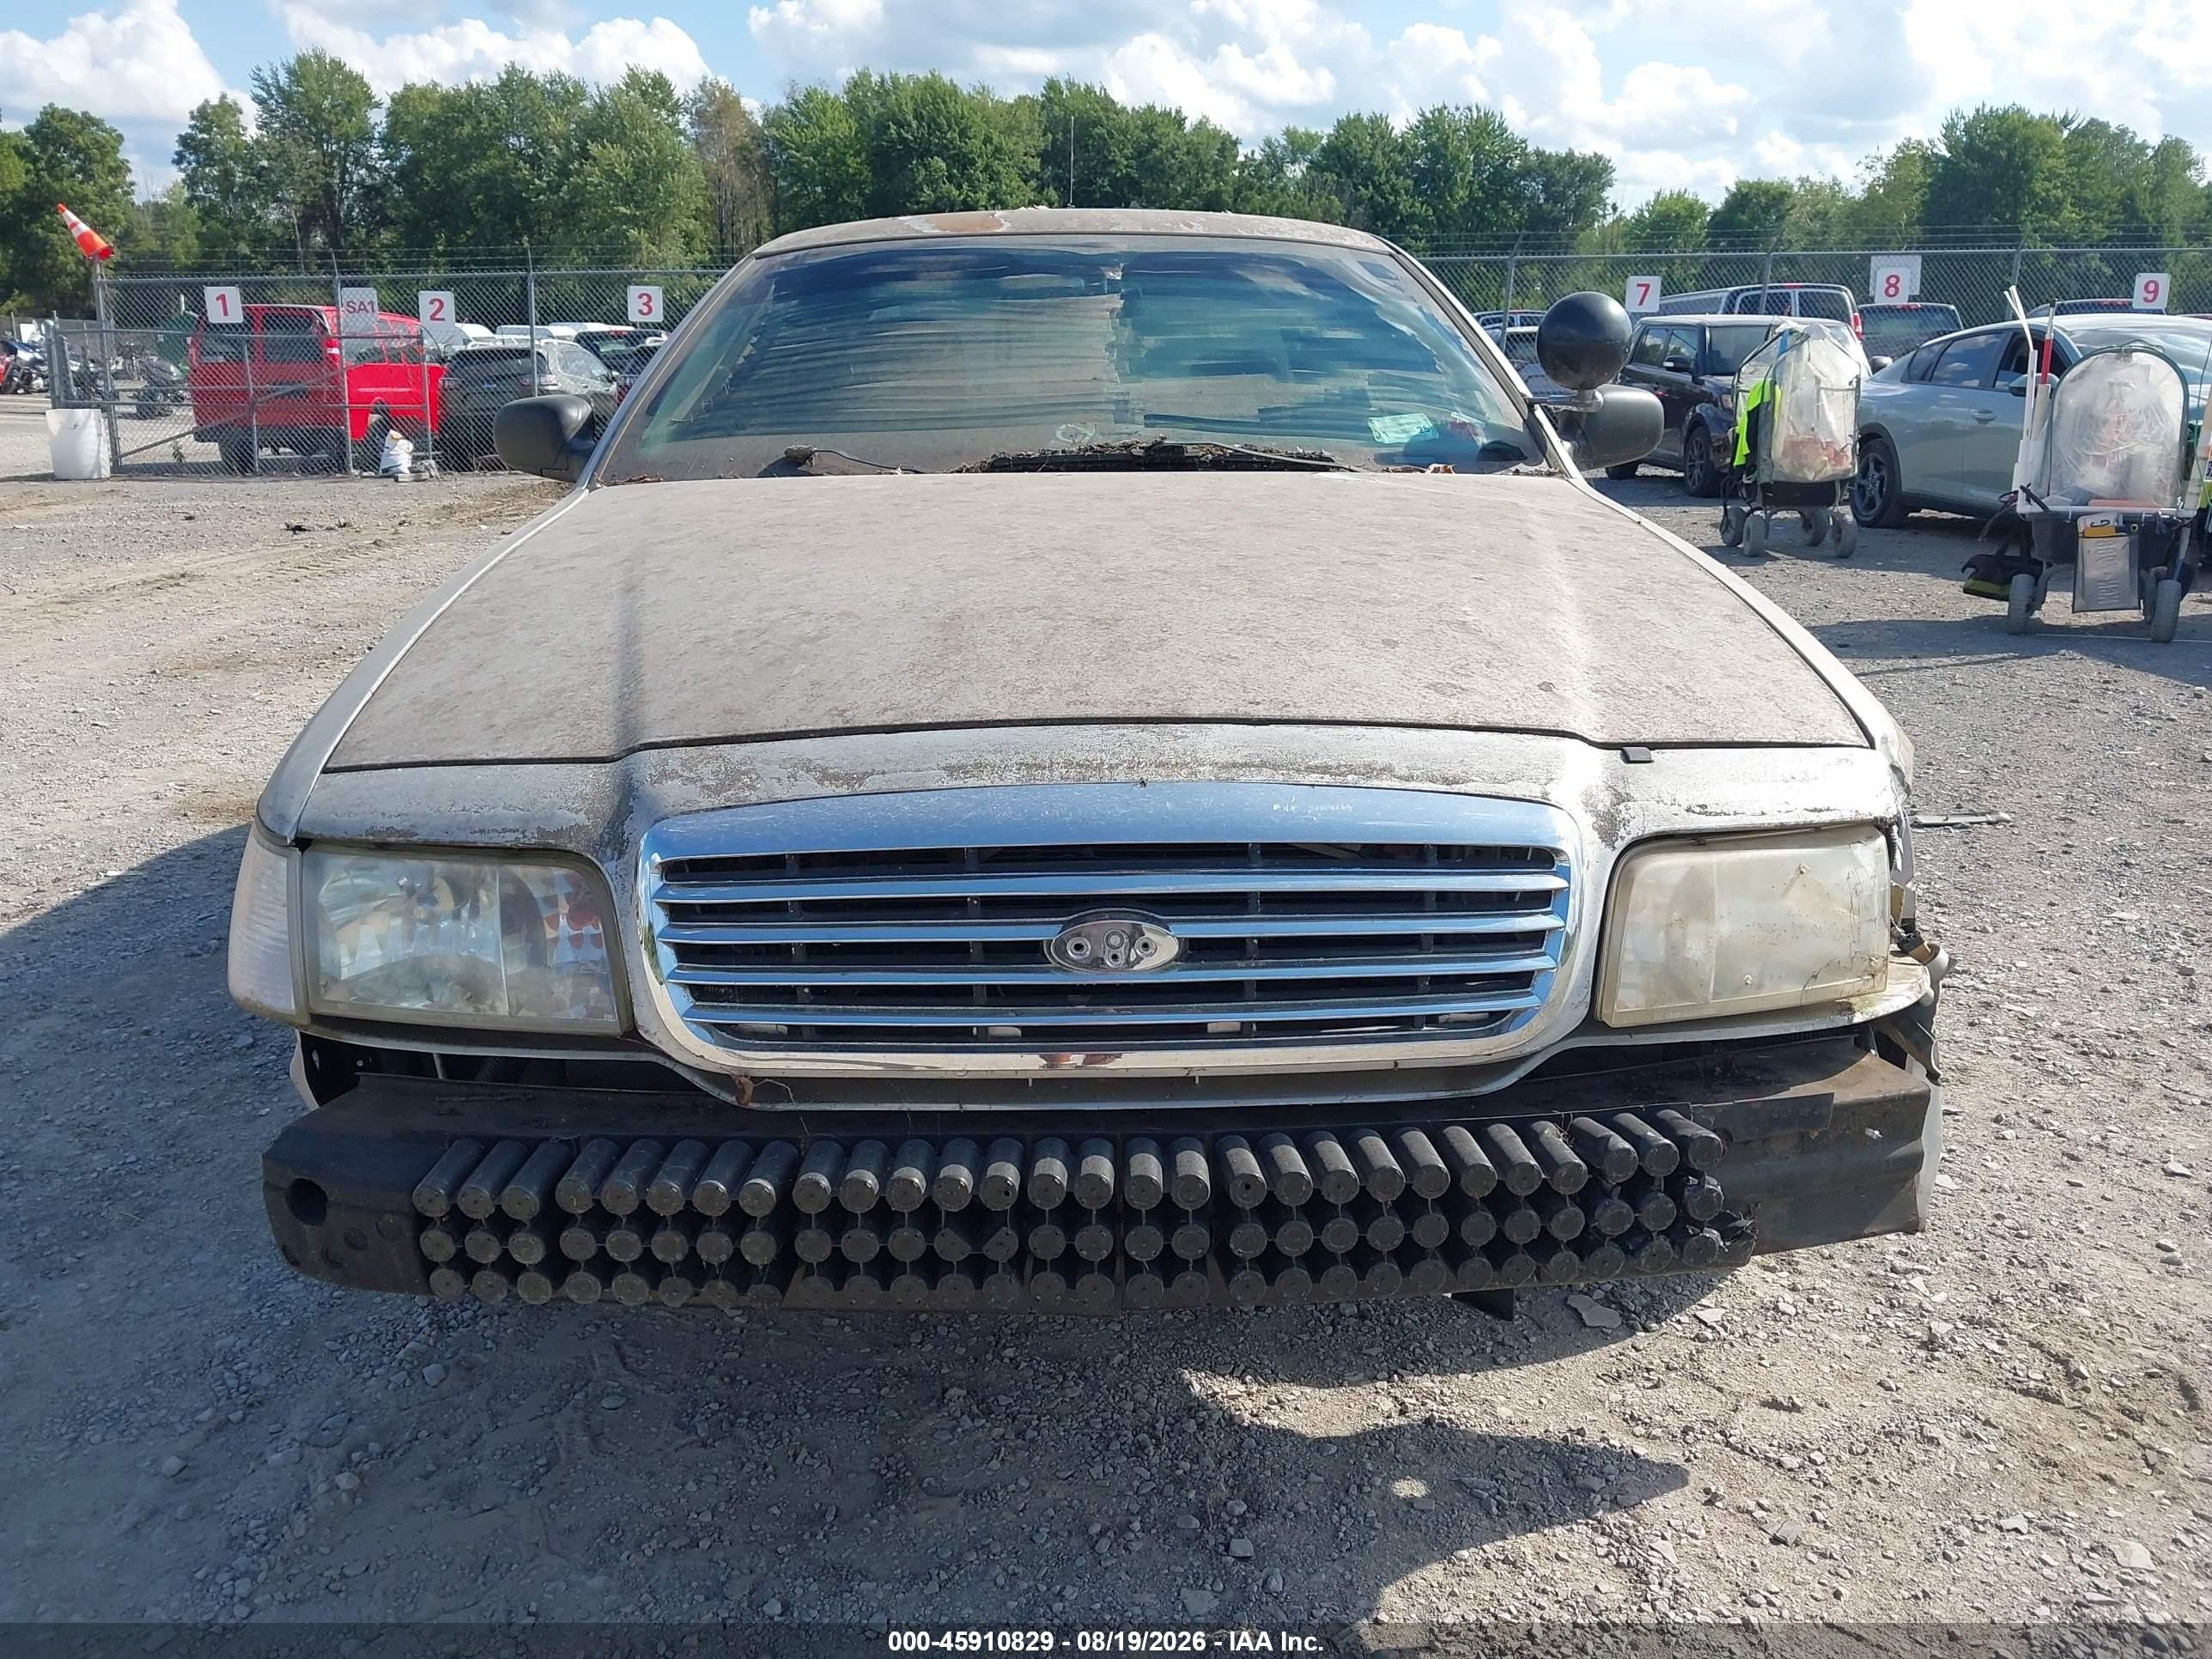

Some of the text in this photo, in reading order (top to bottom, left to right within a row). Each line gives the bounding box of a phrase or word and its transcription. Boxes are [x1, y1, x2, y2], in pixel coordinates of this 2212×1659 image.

[1636, 283, 1650, 306] 7
[1885, 275, 1900, 297] 8
[2143, 281, 2159, 302] 9
[216, 294, 228, 316] 1
[346, 301, 375, 314] SA1
[428, 298, 446, 321] 2
[637, 293, 653, 316] 3
